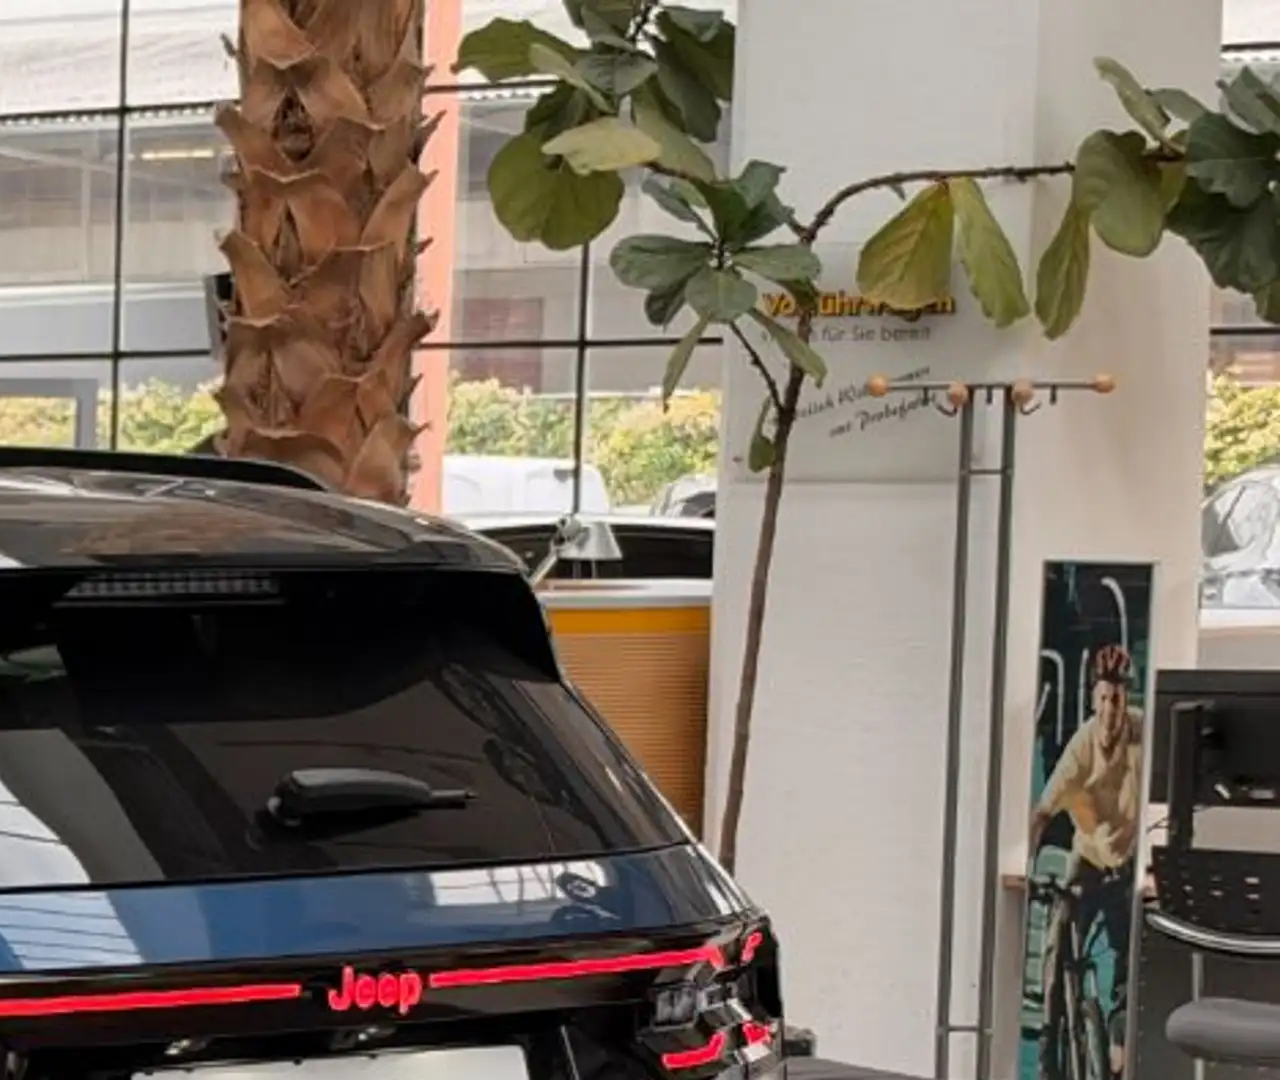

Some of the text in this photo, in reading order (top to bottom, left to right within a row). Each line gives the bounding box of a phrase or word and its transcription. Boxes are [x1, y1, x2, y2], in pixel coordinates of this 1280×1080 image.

[852, 326, 875, 342] Sie
[881, 326, 932, 342] bereit
[328, 964, 423, 1016] Jeep
